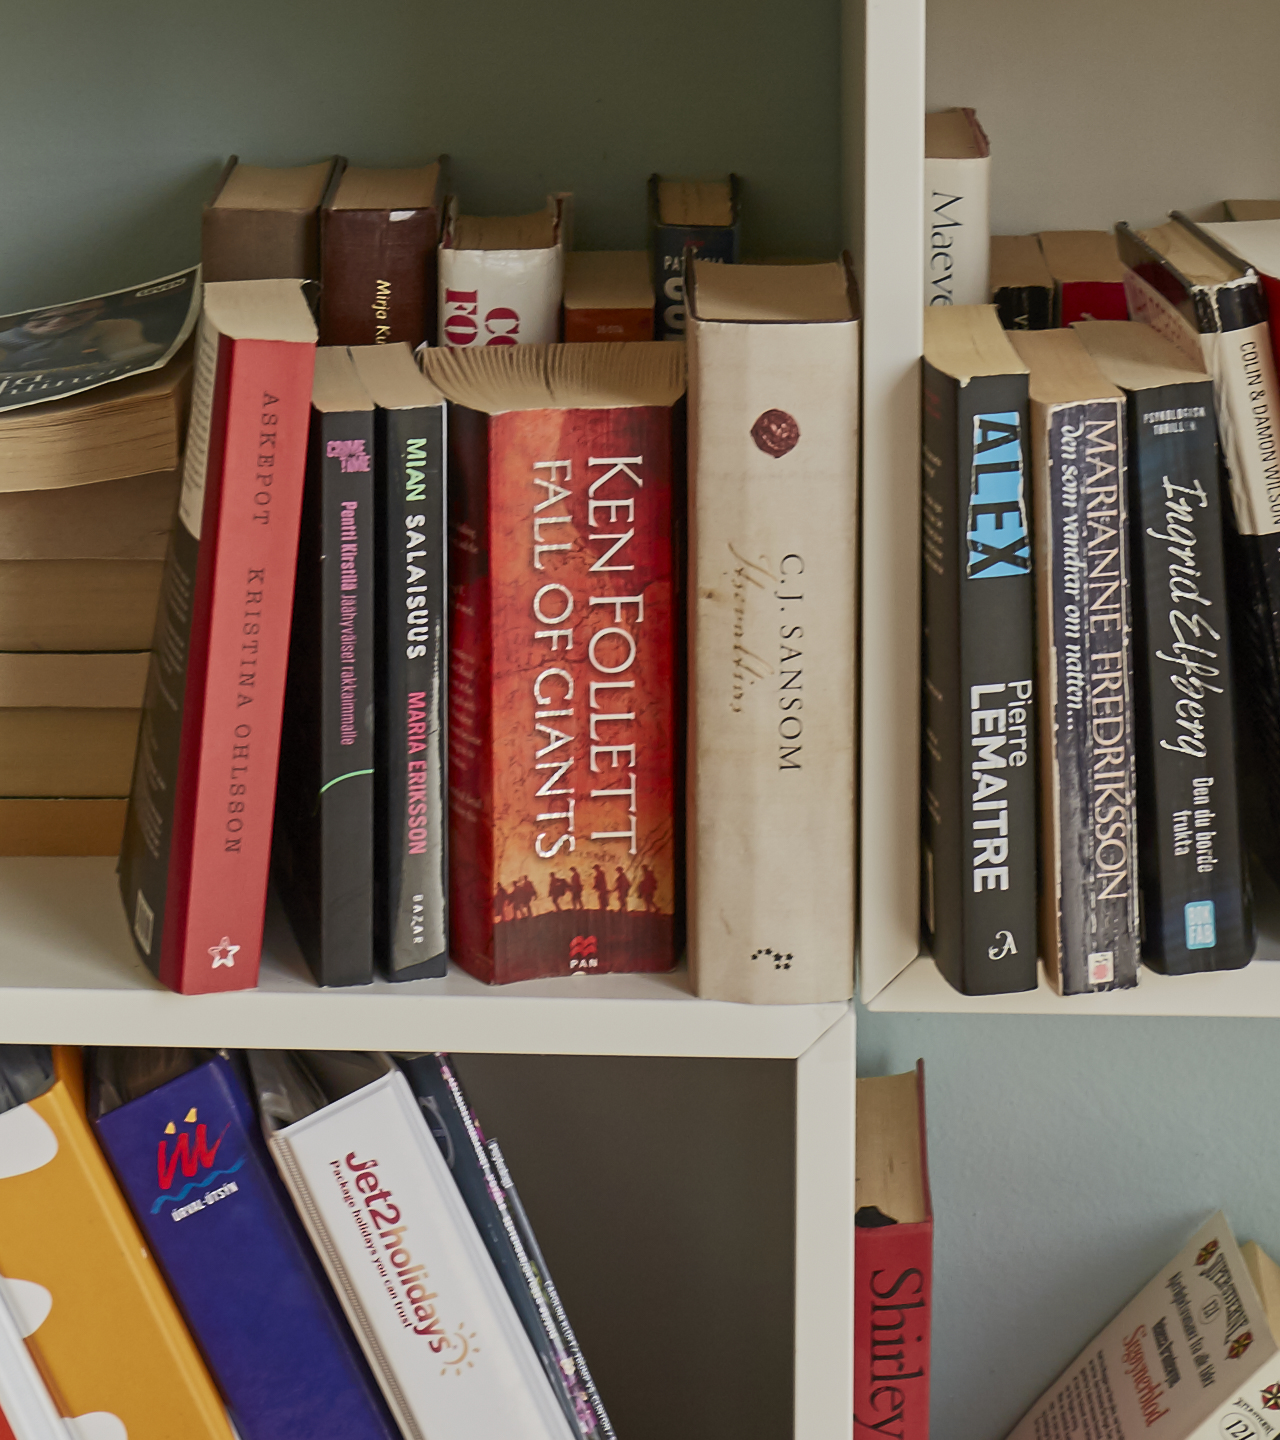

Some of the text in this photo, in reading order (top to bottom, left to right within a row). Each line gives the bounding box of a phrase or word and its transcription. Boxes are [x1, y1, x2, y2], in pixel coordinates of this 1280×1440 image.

[224, 391, 279, 855] ASKEPOT KRISTINA OHLSSON
[404, 437, 430, 855] MIAN SALAISUUS MARIA ERIKSSON
[968, 414, 1031, 578] ALEX
[532, 458, 575, 860] FALL OF GIANTS
[586, 455, 644, 856] KEN FOLLETT
[968, 684, 1010, 893] LEMAITRE
[1008, 679, 1034, 768] Pierre
[1084, 418, 1131, 901] MARIANNE FREDRIKSSON
[570, 956, 598, 968] PAN
[345, 1150, 452, 1354] Jet2holidays
